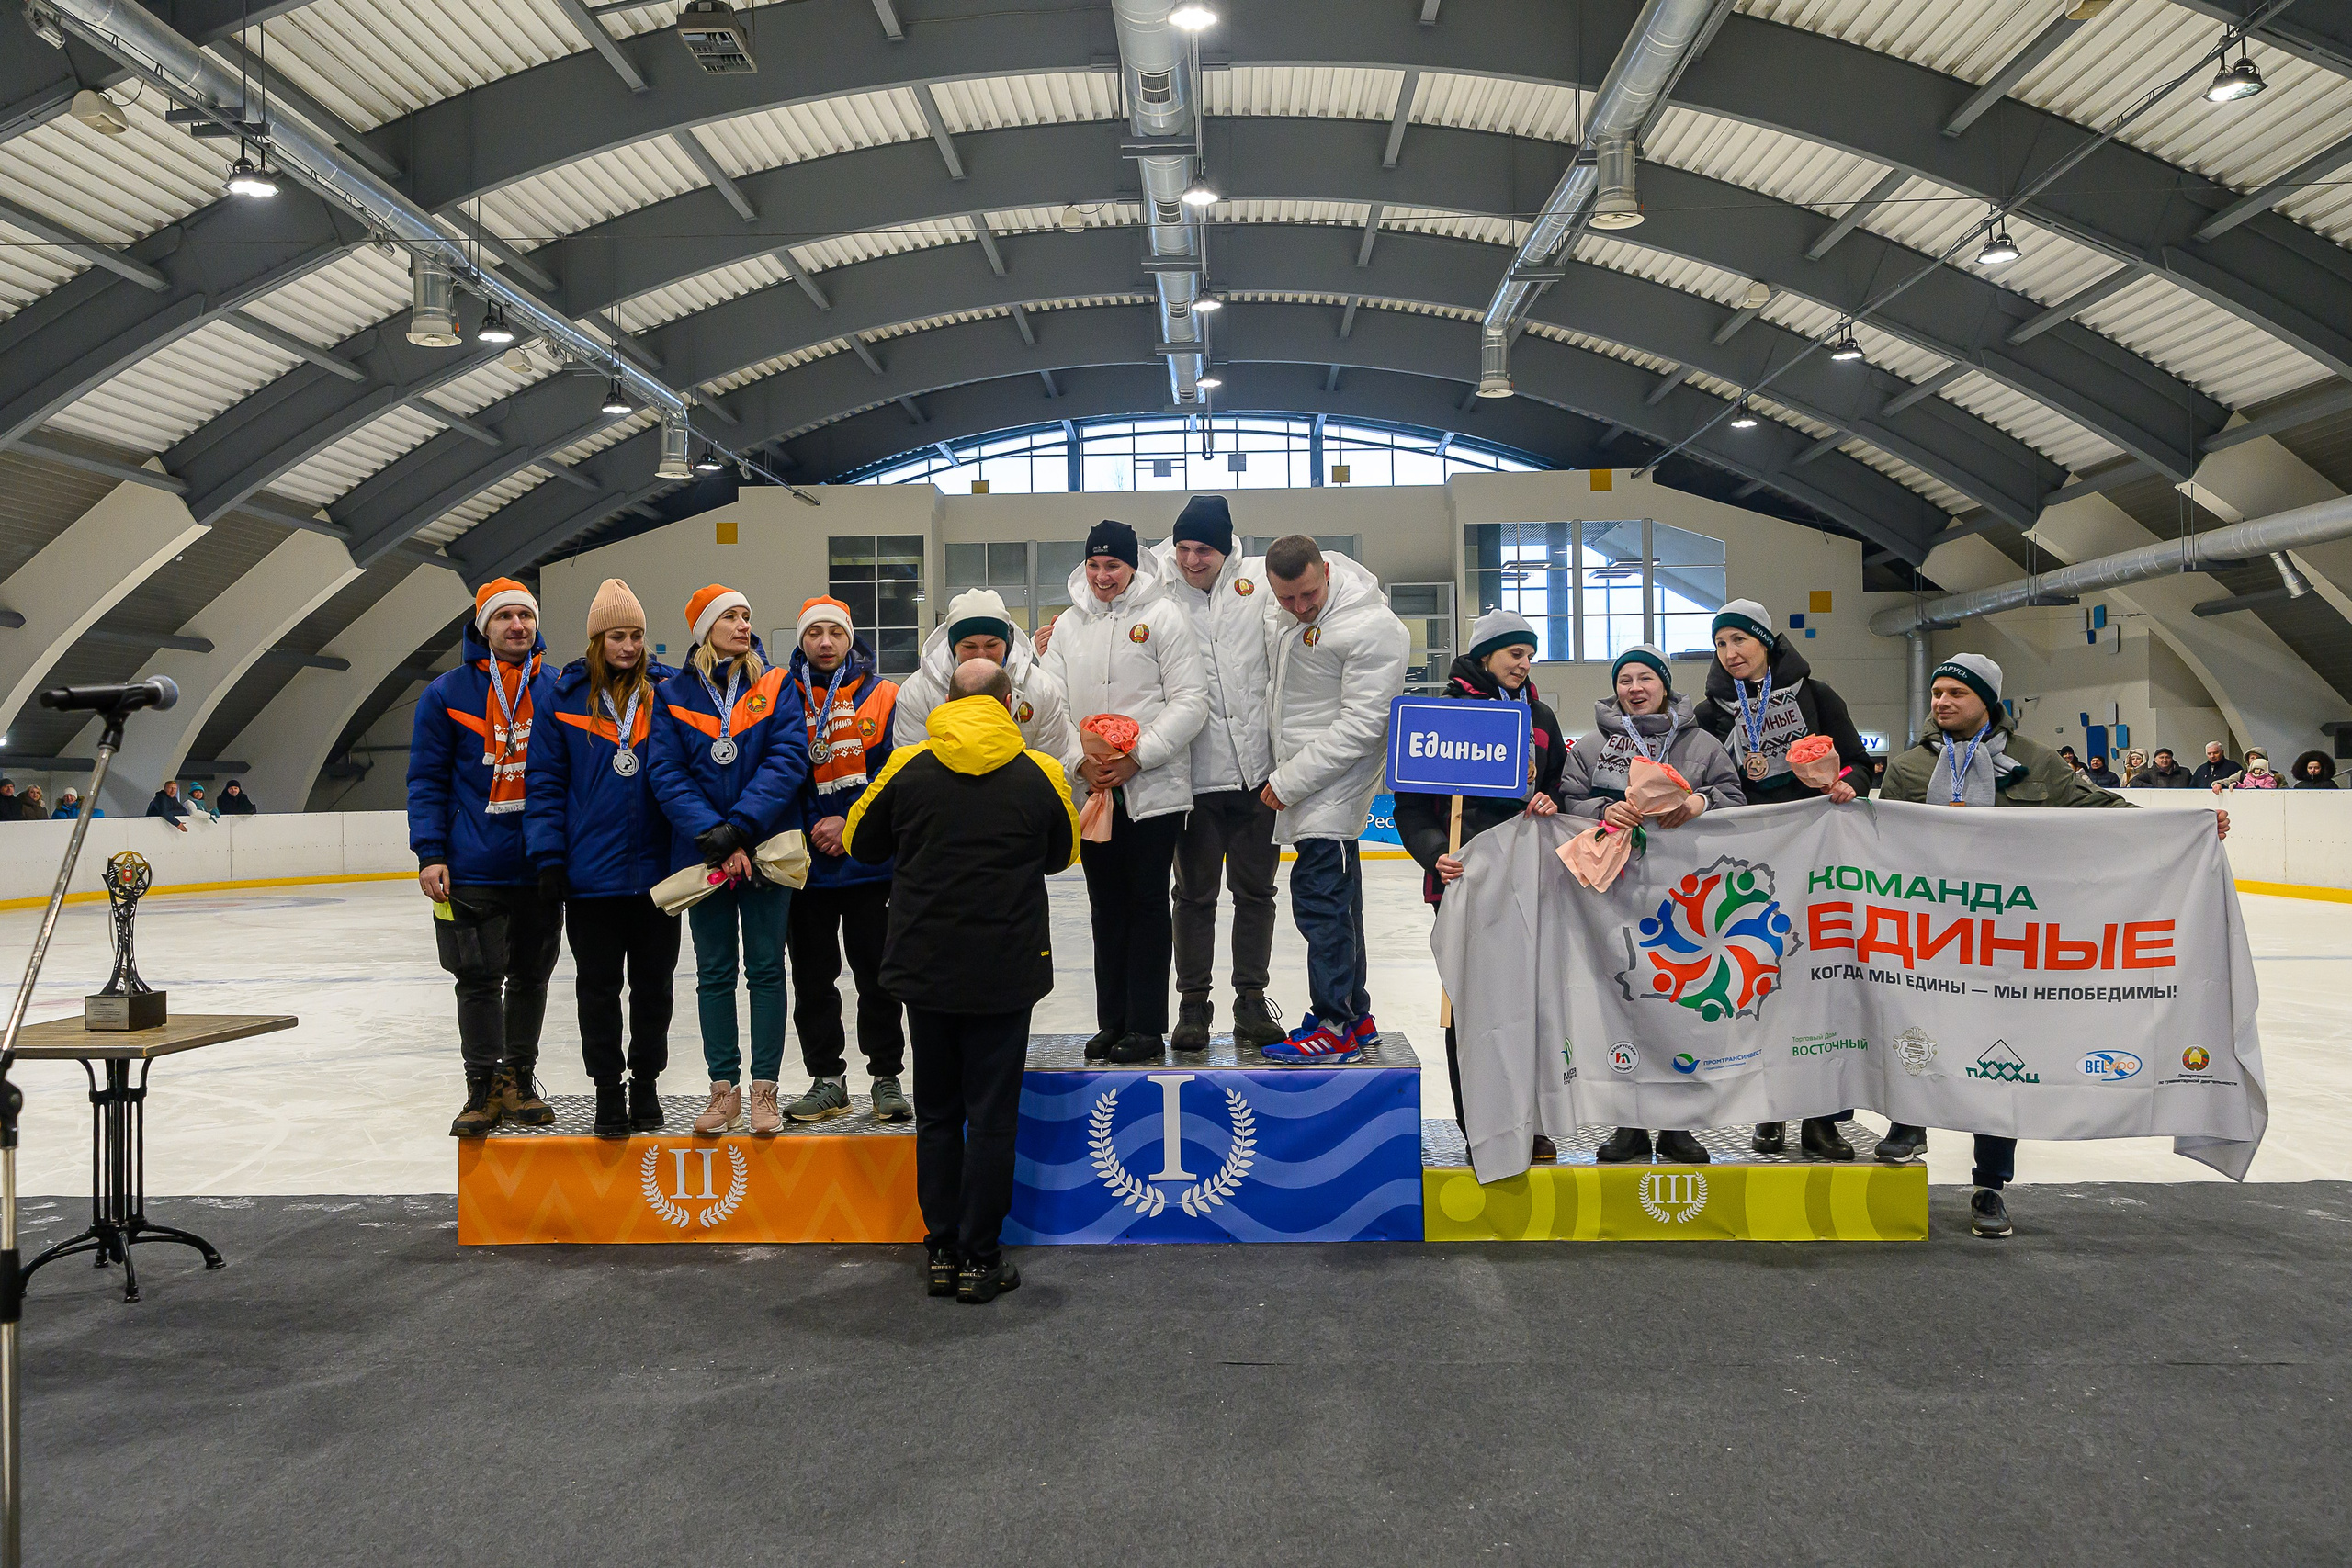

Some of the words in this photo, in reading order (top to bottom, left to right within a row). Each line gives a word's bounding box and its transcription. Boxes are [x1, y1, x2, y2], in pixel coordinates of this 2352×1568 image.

[1741, 709, 1798, 738] ЕИНЫЕ
[1408, 731, 1508, 762] Единые
[1807, 865, 2038, 915] КОМАНДА
[1807, 901, 2177, 971] ЕДИНЫЕ
[1810, 964, 1864, 981] КОГДА
[1868, 968, 1902, 986] МЫ
[1905, 973, 1966, 995] ЕДИНЫ
[1994, 984, 2028, 999] МЫ
[2033, 985, 2177, 1003] НЕПОБЕДИМЫ!
[1703, 1048, 1763, 1066] ПРОМТРАНСИНВЕСТ
[1792, 1038, 1869, 1056] ВОСТОЧНЫЙ
[668, 1148, 719, 1199] II
[1650, 1174, 1697, 1204] III
